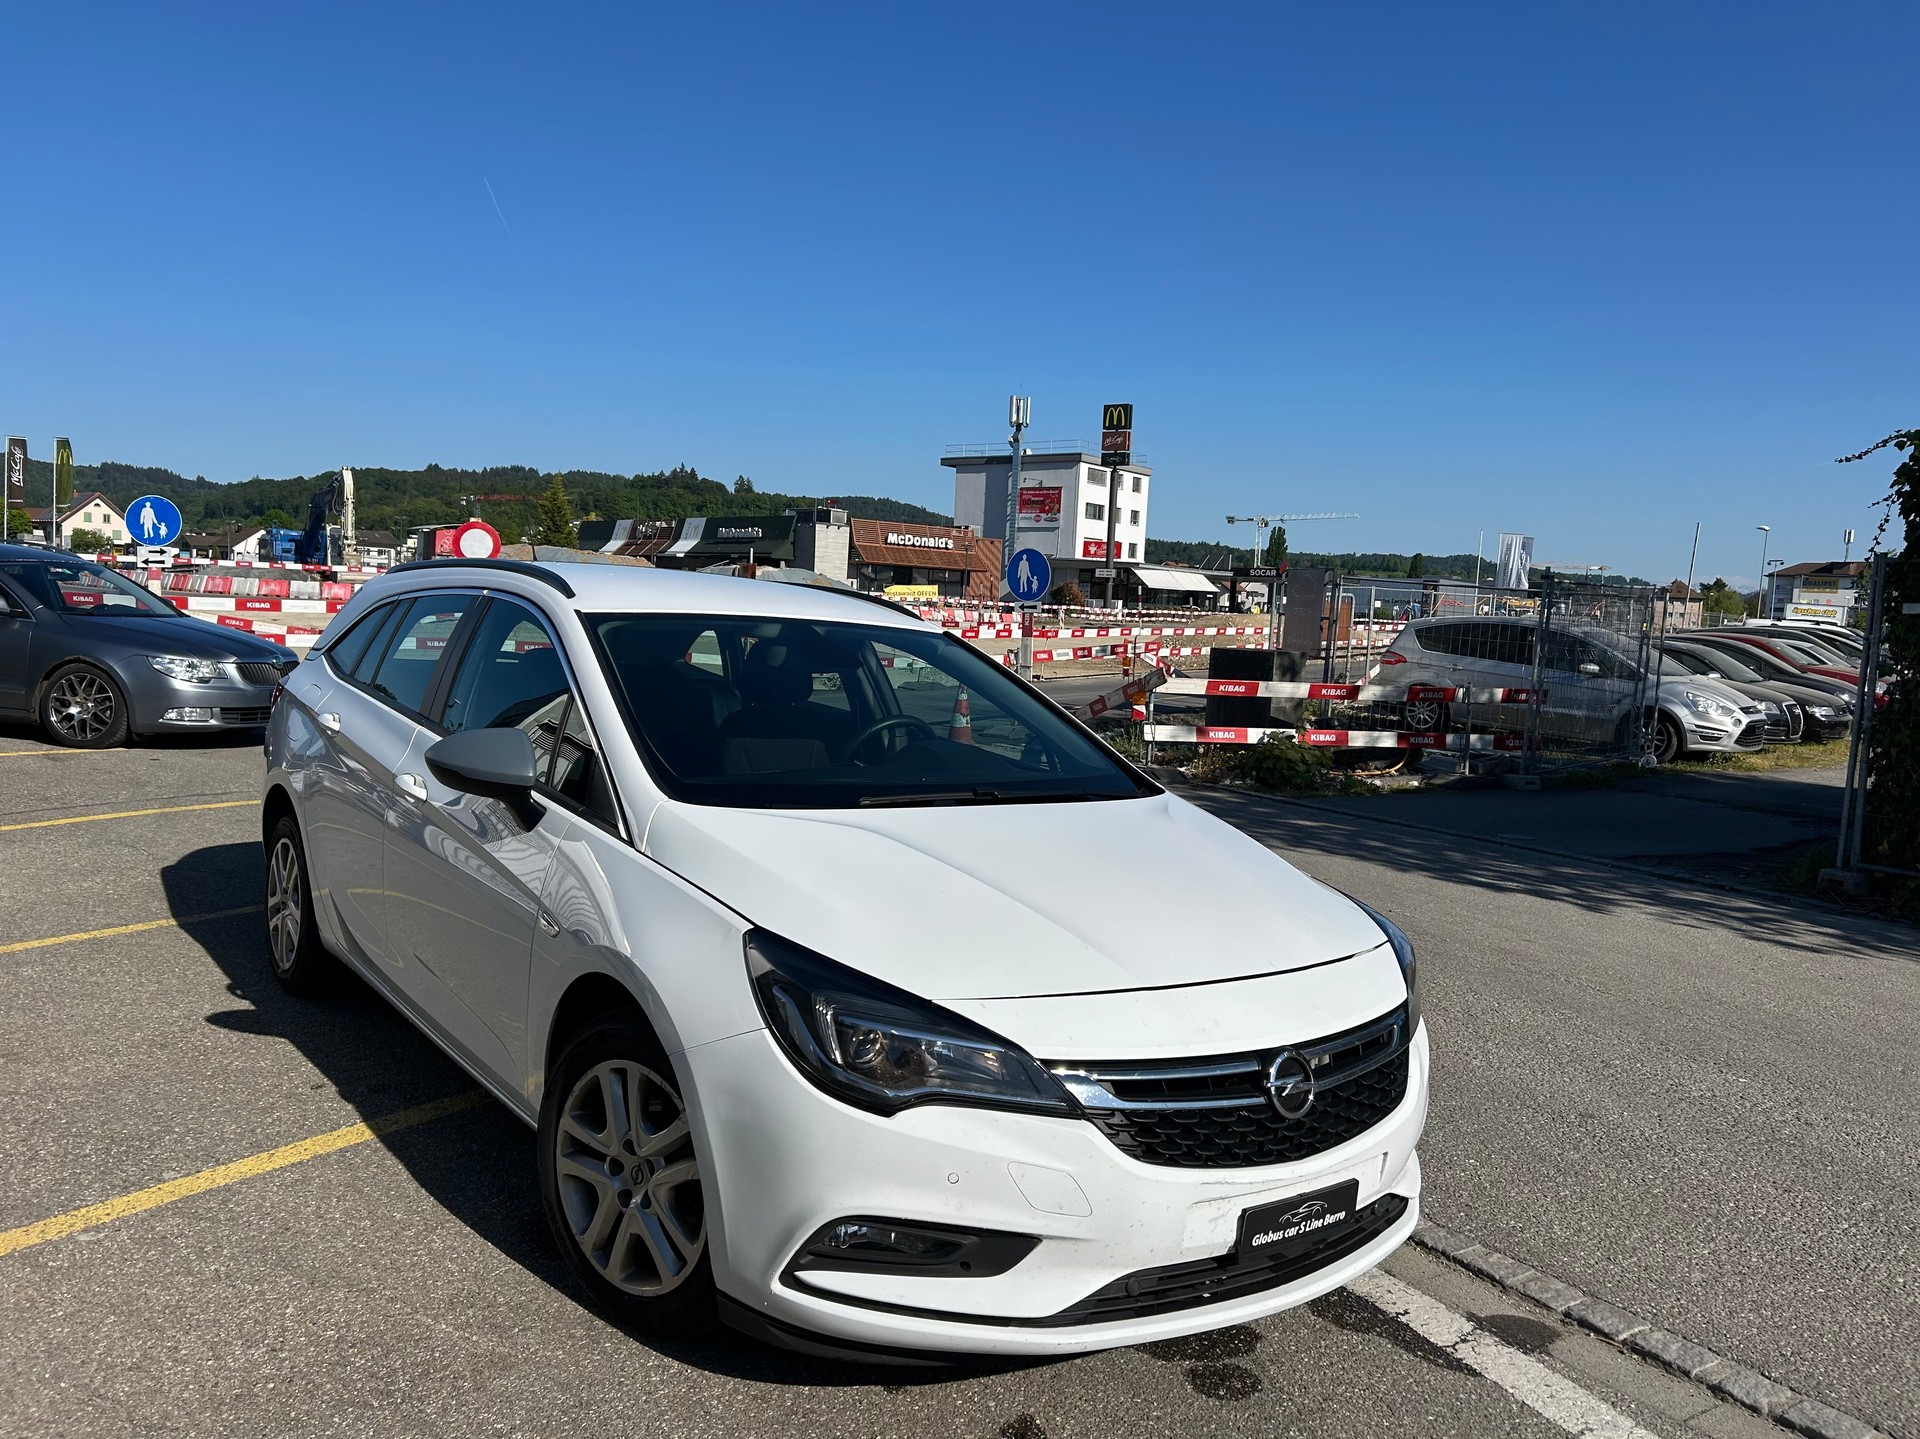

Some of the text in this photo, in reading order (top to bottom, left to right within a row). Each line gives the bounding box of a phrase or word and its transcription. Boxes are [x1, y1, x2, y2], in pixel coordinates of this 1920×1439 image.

[887, 532, 954, 549] McDonald's
[1249, 569, 1277, 577] SOCAR
[1219, 684, 1246, 693] KIBAG
[1321, 688, 1347, 696] KIBAG
[1419, 690, 1444, 699] KIBAG
[1209, 731, 1236, 739] KIBAG
[1310, 733, 1336, 742] KIBAG
[1409, 736, 1435, 744] KIBAG
[1252, 1211, 1346, 1247] Globus car S Line Berro
